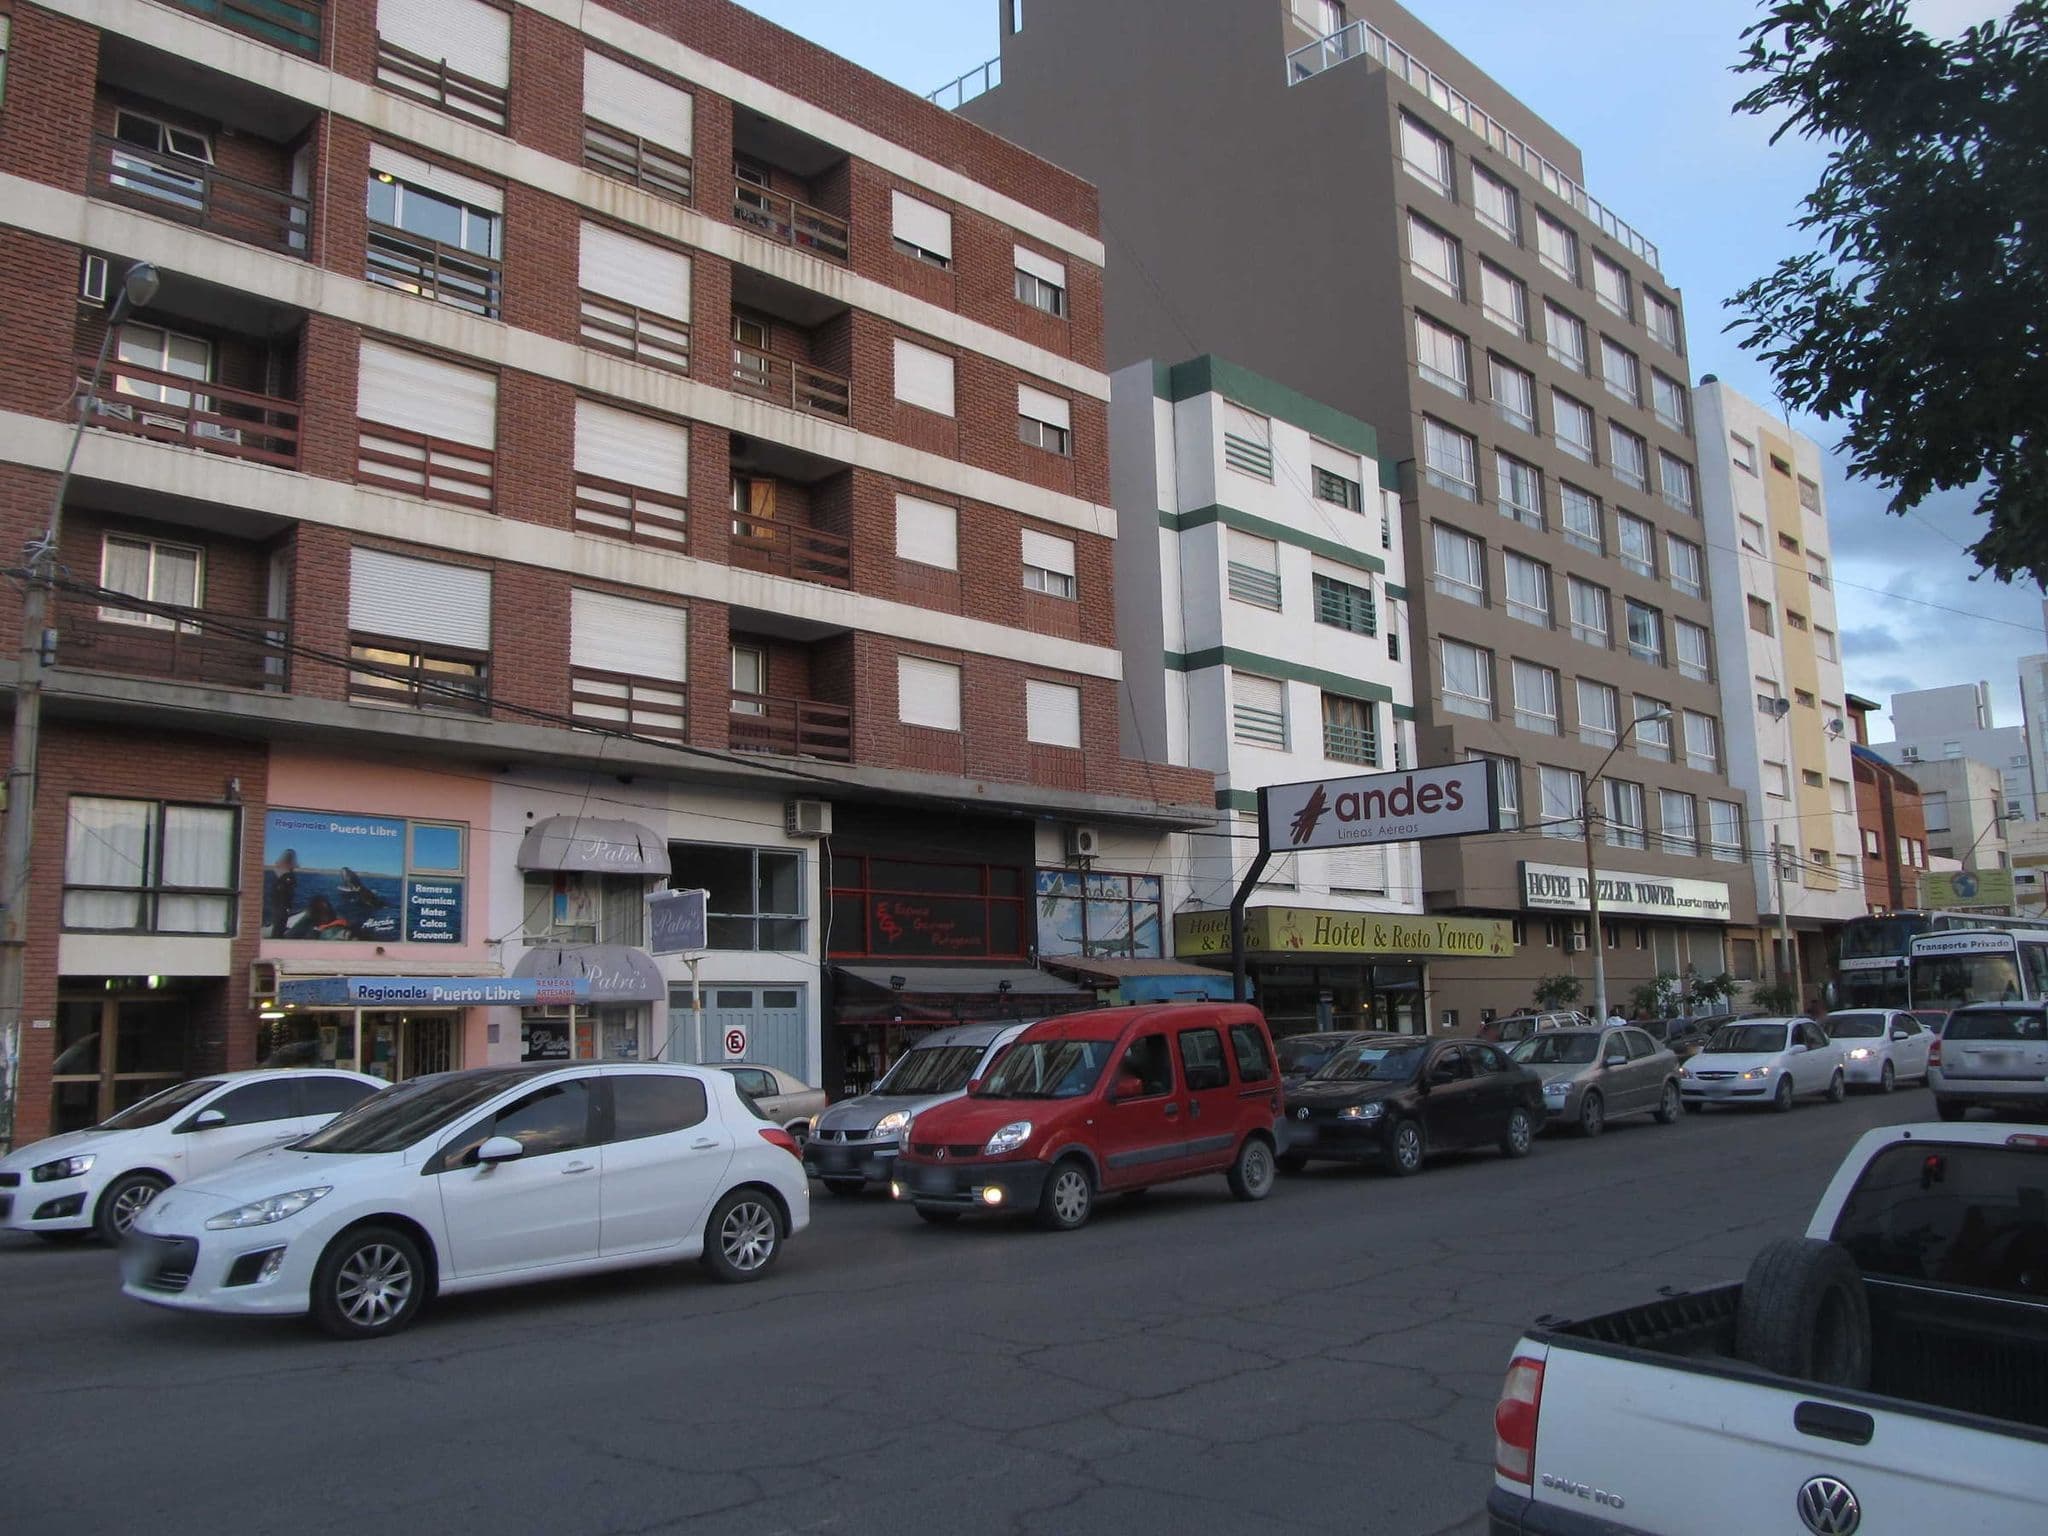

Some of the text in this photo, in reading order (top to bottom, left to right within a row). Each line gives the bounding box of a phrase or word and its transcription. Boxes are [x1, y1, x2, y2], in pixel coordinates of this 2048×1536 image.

[1335, 775, 1464, 822] andes
[330, 822, 367, 835] Puerto
[370, 825, 397, 837] Libre
[415, 883, 453, 894] Remeras
[1528, 872, 1730, 911] HOTEL DZZLER TOWER puerto madryn
[411, 895, 456, 906] Ceramicas
[420, 907, 447, 917] Mates
[420, 919, 447, 929] Calcos
[1189, 914, 1230, 934] Hotel
[412, 930, 454, 940] Souvenirs
[1312, 916, 1485, 951] Hotel & Resto Yanco
[1201, 933, 1261, 951] & Rto
[1916, 939, 2010, 952] Transporte Privado
[358, 985, 428, 1001] Regionales
[432, 985, 482, 1001] Puerto
[485, 985, 522, 1001] Libre
